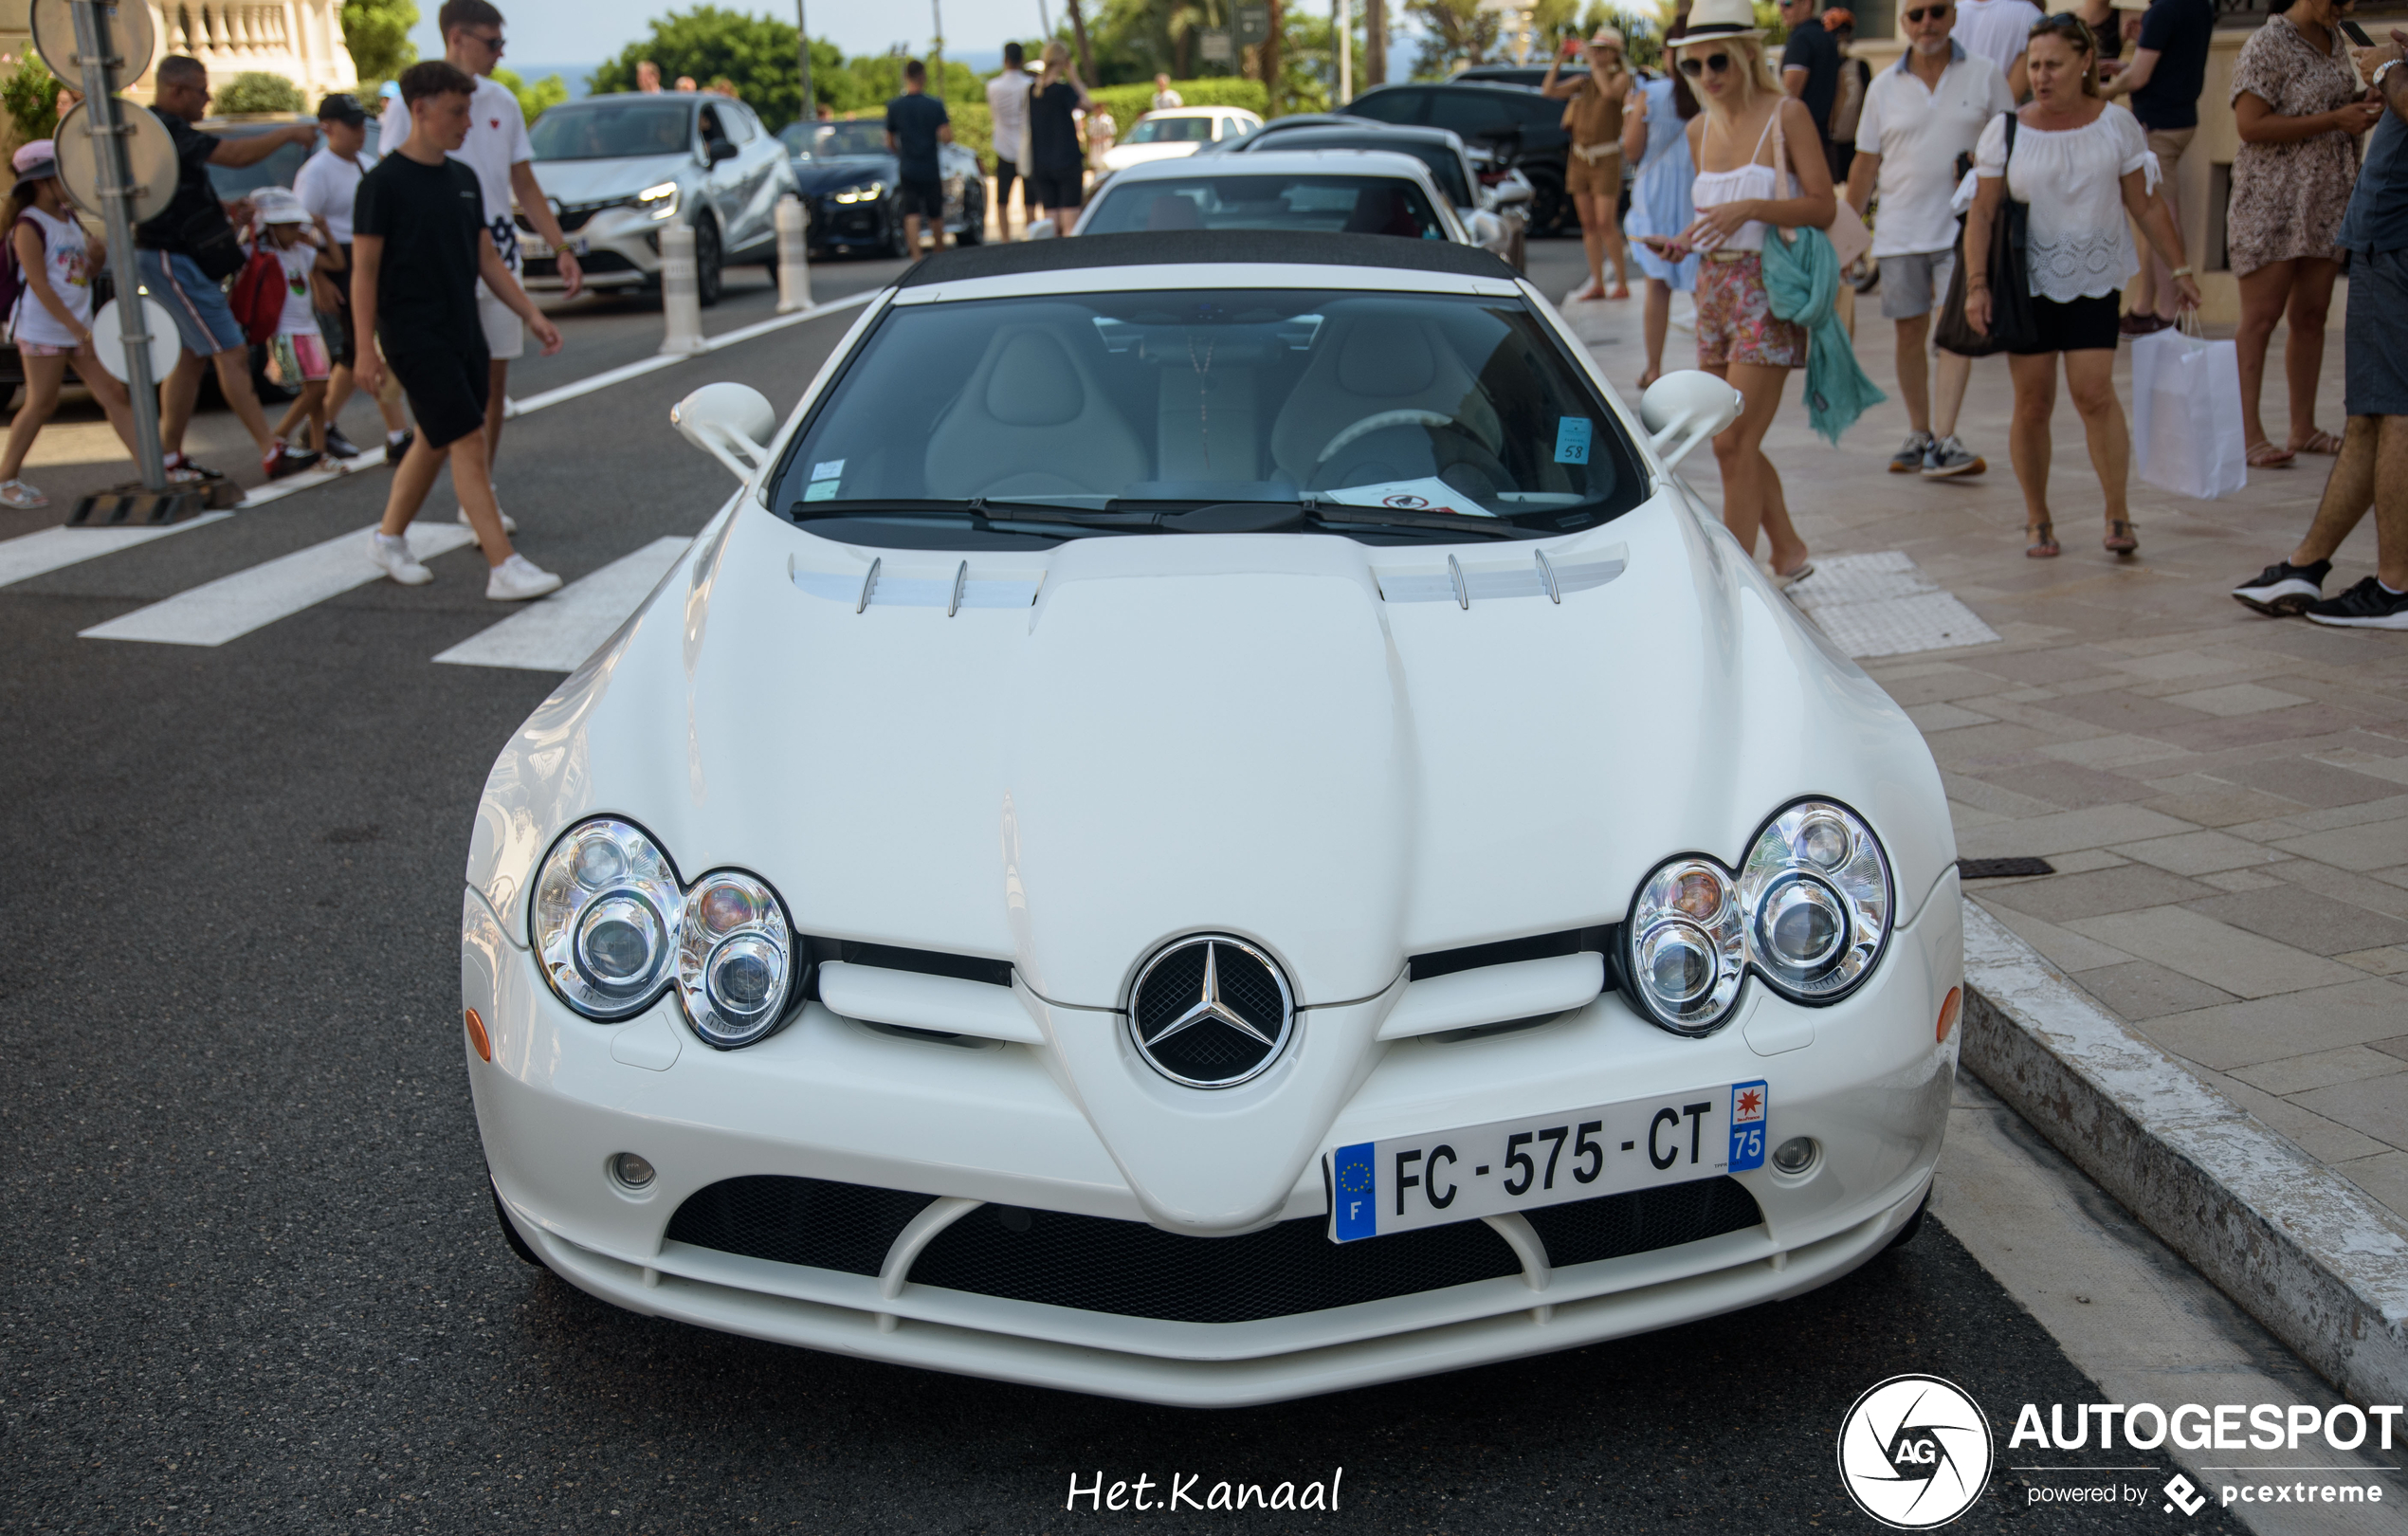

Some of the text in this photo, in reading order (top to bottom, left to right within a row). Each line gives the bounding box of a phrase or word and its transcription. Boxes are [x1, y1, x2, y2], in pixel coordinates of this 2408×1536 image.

[1564, 445, 1583, 459] 58
[1734, 1129, 1760, 1160] 75
[1350, 1201, 1361, 1220] F
